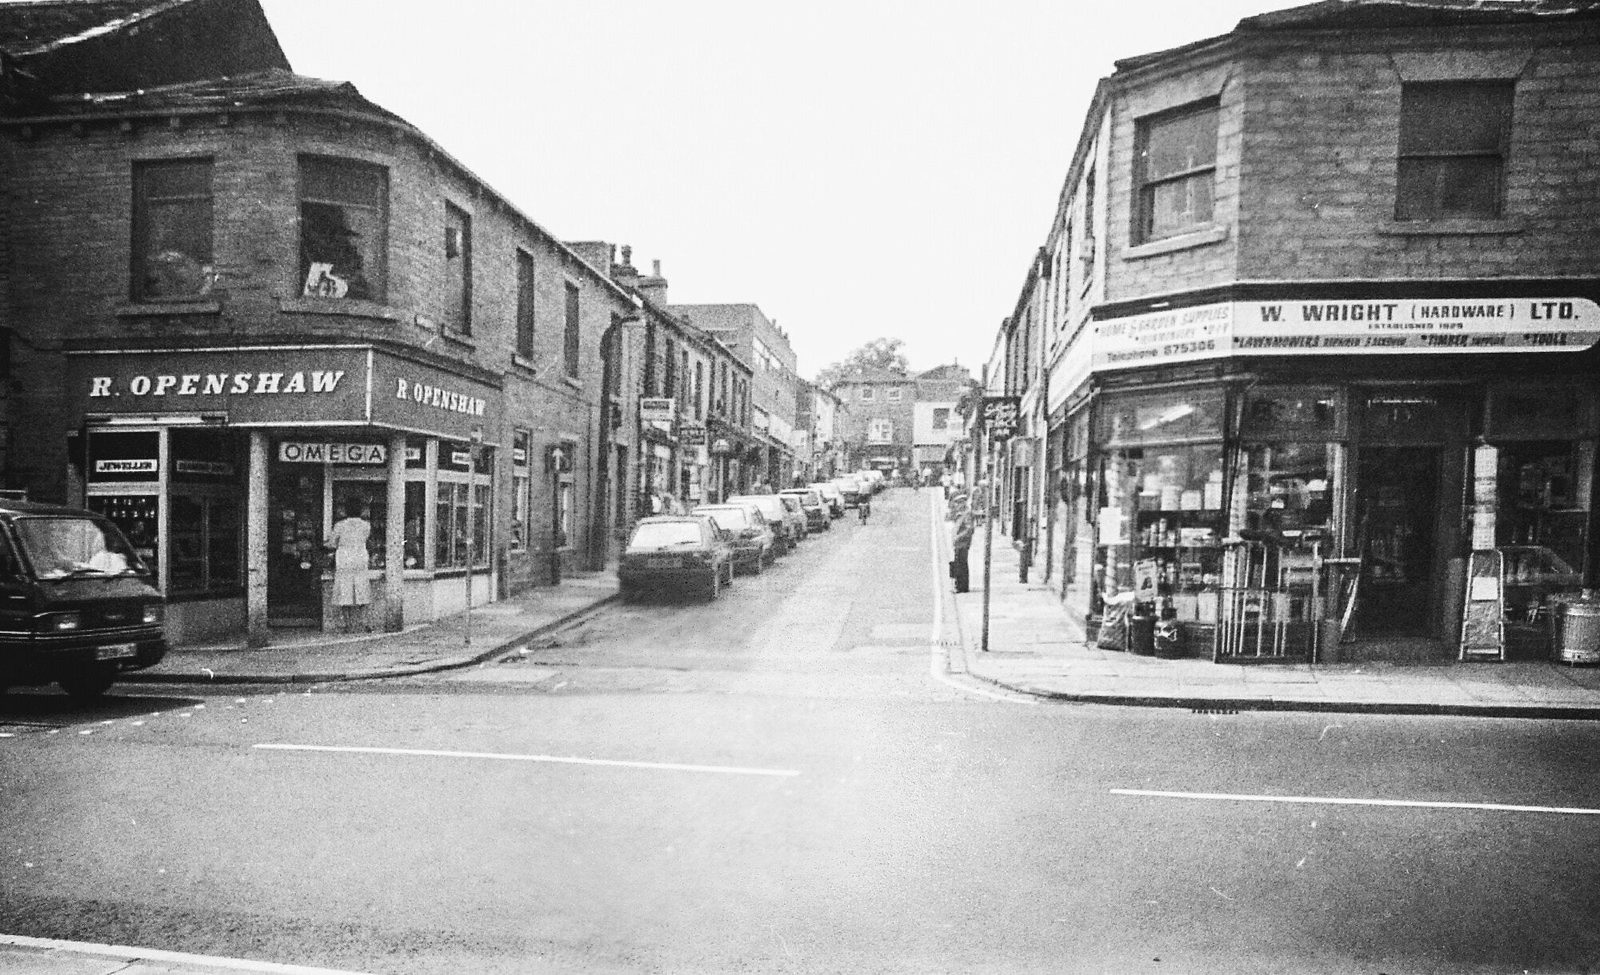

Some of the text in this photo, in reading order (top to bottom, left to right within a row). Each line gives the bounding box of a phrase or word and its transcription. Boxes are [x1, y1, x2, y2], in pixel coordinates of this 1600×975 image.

[1181, 306, 1230, 326] SUPPLIES
[1260, 302, 1580, 322] W. WRIGHT (HARDWARE) LTD.
[1368, 322, 1434, 330] ESTABLISHED
[1107, 348, 1159, 363] Telephone
[90, 370, 345, 398] R. OPENSHAW
[414, 383, 486, 415] OPENSHAW
[285, 444, 383, 462] OMEGA
[101, 461, 153, 471] JEWELLER
